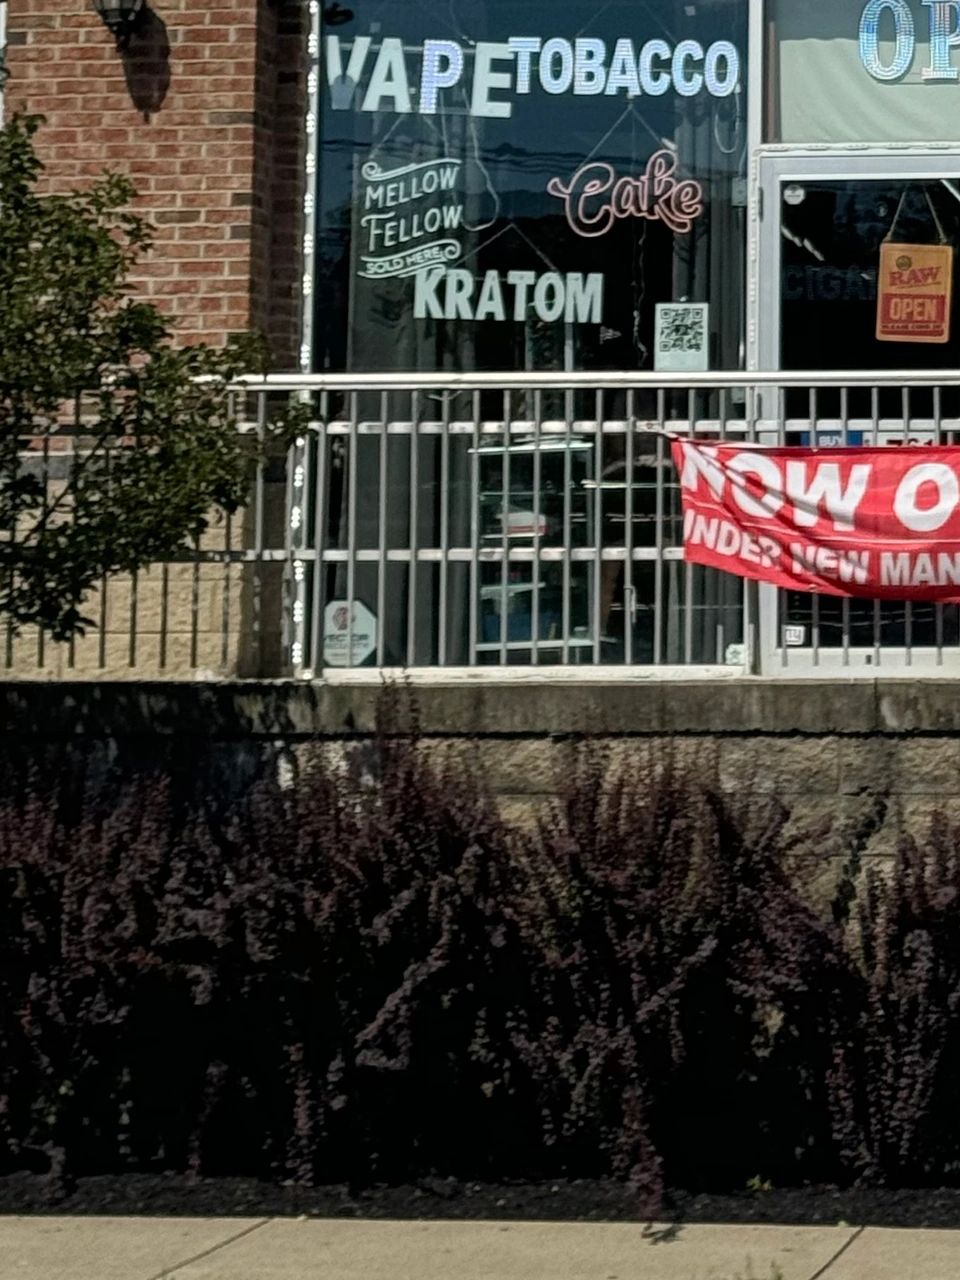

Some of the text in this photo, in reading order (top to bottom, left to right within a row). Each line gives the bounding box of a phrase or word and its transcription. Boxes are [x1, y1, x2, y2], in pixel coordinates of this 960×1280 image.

[326, 34, 514, 119] VAPE
[508, 35, 741, 98] TOBACCO
[364, 164, 460, 210] MELLOW
[547, 148, 703, 238] Cake
[360, 205, 463, 253] FELLOW
[366, 246, 444, 274] SOLD HERE
[888, 266, 943, 287] RAW
[413, 270, 605, 325] KRATOM
[889, 298, 938, 322] OPEN
[680, 442, 873, 532] NOW
[791, 541, 871, 585] NEW
